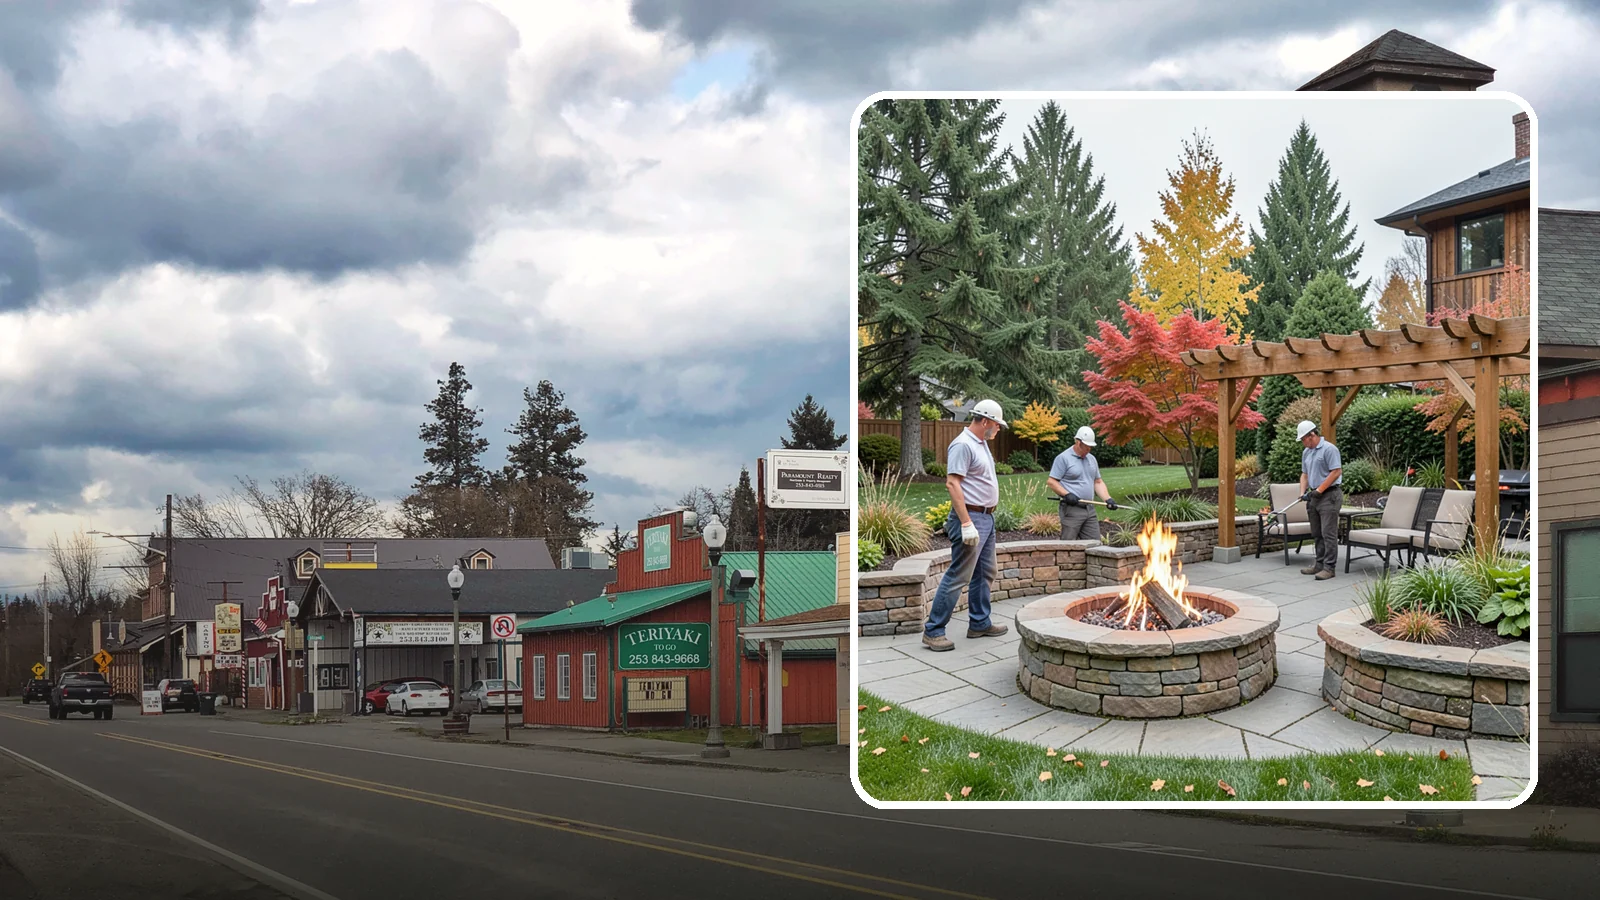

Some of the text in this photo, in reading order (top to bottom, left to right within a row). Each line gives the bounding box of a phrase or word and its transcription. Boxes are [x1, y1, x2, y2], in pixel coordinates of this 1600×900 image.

[625, 627, 702, 646] TERIYAKI
[629, 654, 700, 664] 253 843-9668
[639, 681, 672, 690] TERIYAKI
